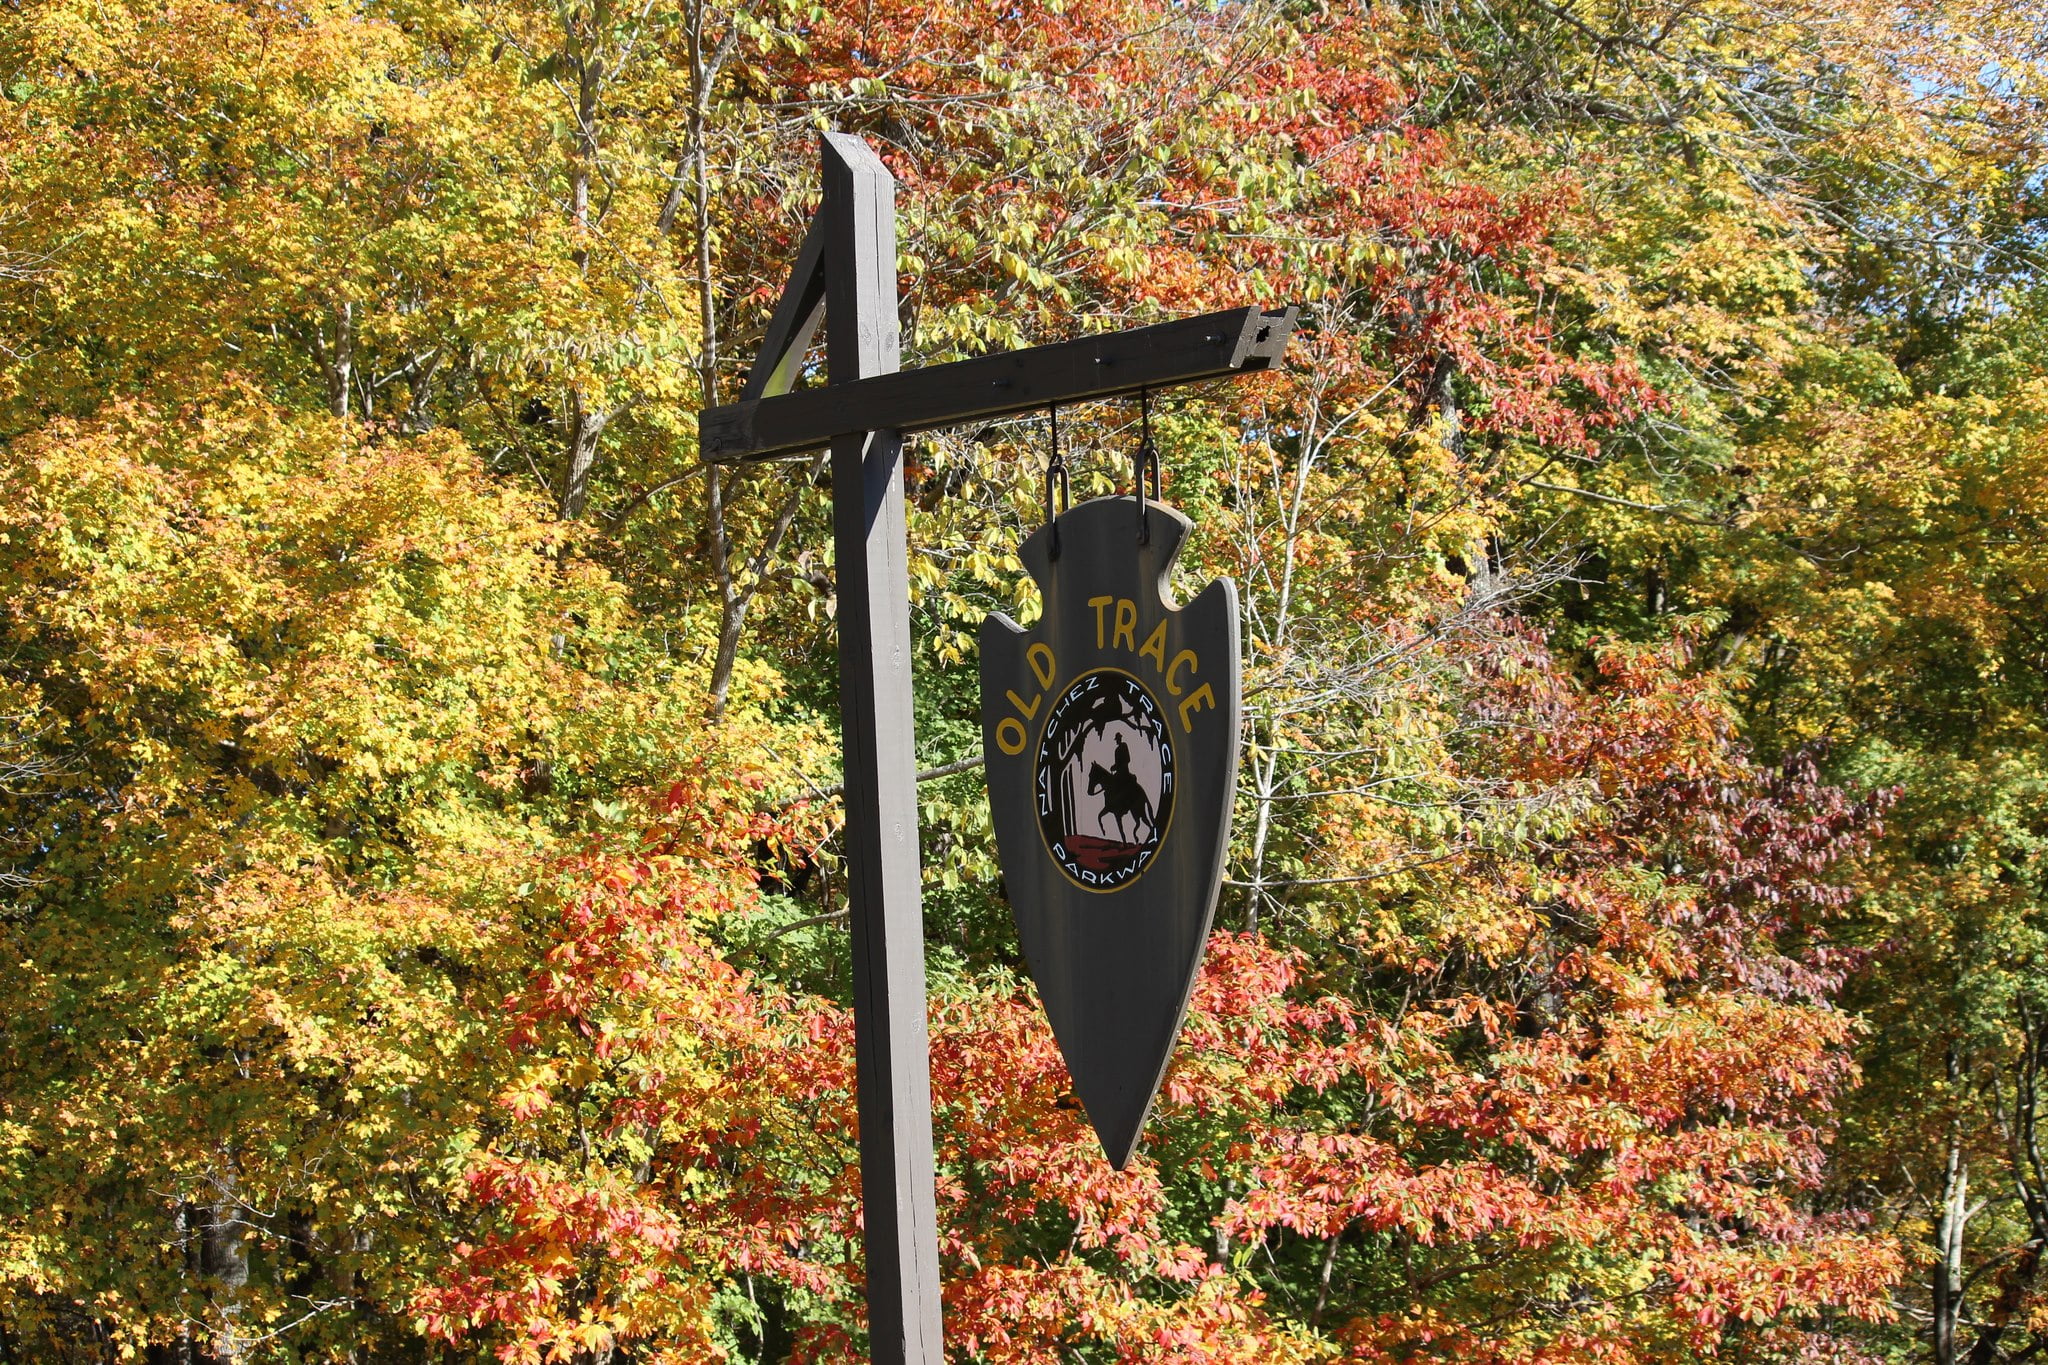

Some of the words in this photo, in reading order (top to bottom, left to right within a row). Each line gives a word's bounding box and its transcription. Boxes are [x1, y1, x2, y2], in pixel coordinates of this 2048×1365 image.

[996, 642, 1056, 755] OLD
[1087, 595, 1216, 734] TRACE
[1039, 676, 1099, 816] NATCHEZ
[1126, 680, 1172, 794] TRACE
[1052, 826, 1158, 884] PARKWAY
